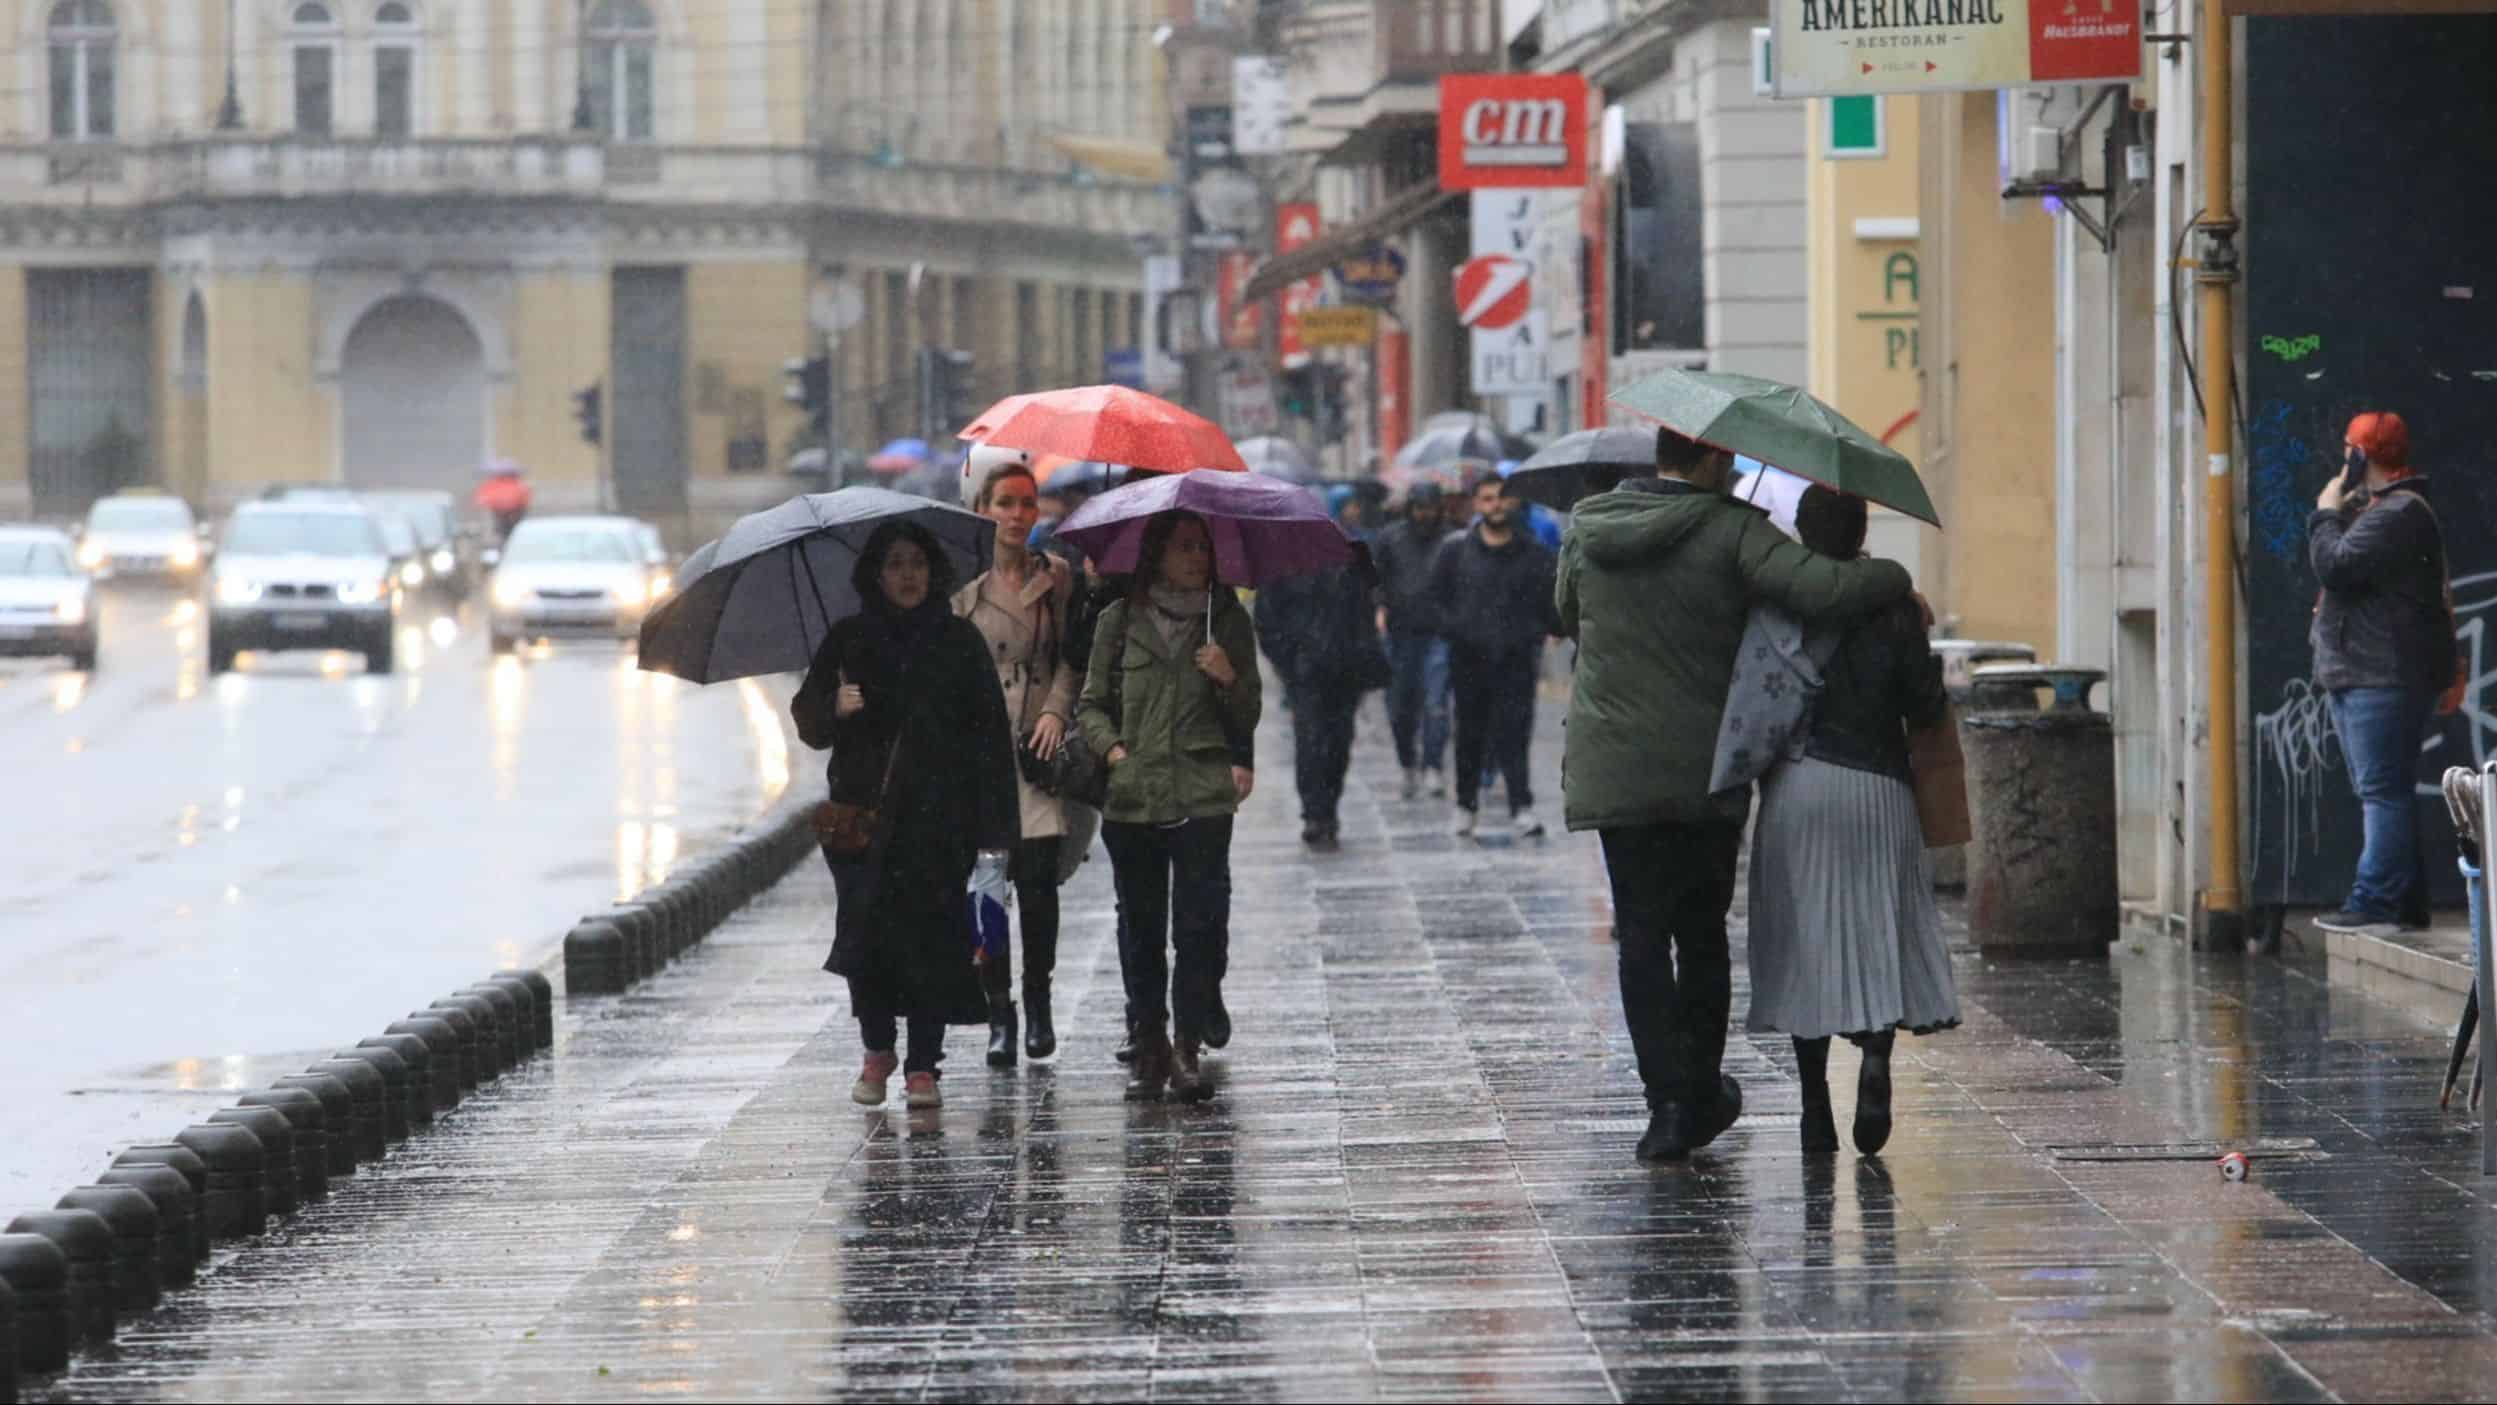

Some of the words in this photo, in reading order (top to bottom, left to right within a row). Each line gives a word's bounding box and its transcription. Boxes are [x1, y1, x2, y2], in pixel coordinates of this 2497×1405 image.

[1801, 0, 2003, 31] AMERIKANAC
[1856, 33, 1948, 48] RESTORAN
[1462, 97, 1566, 145] cm
